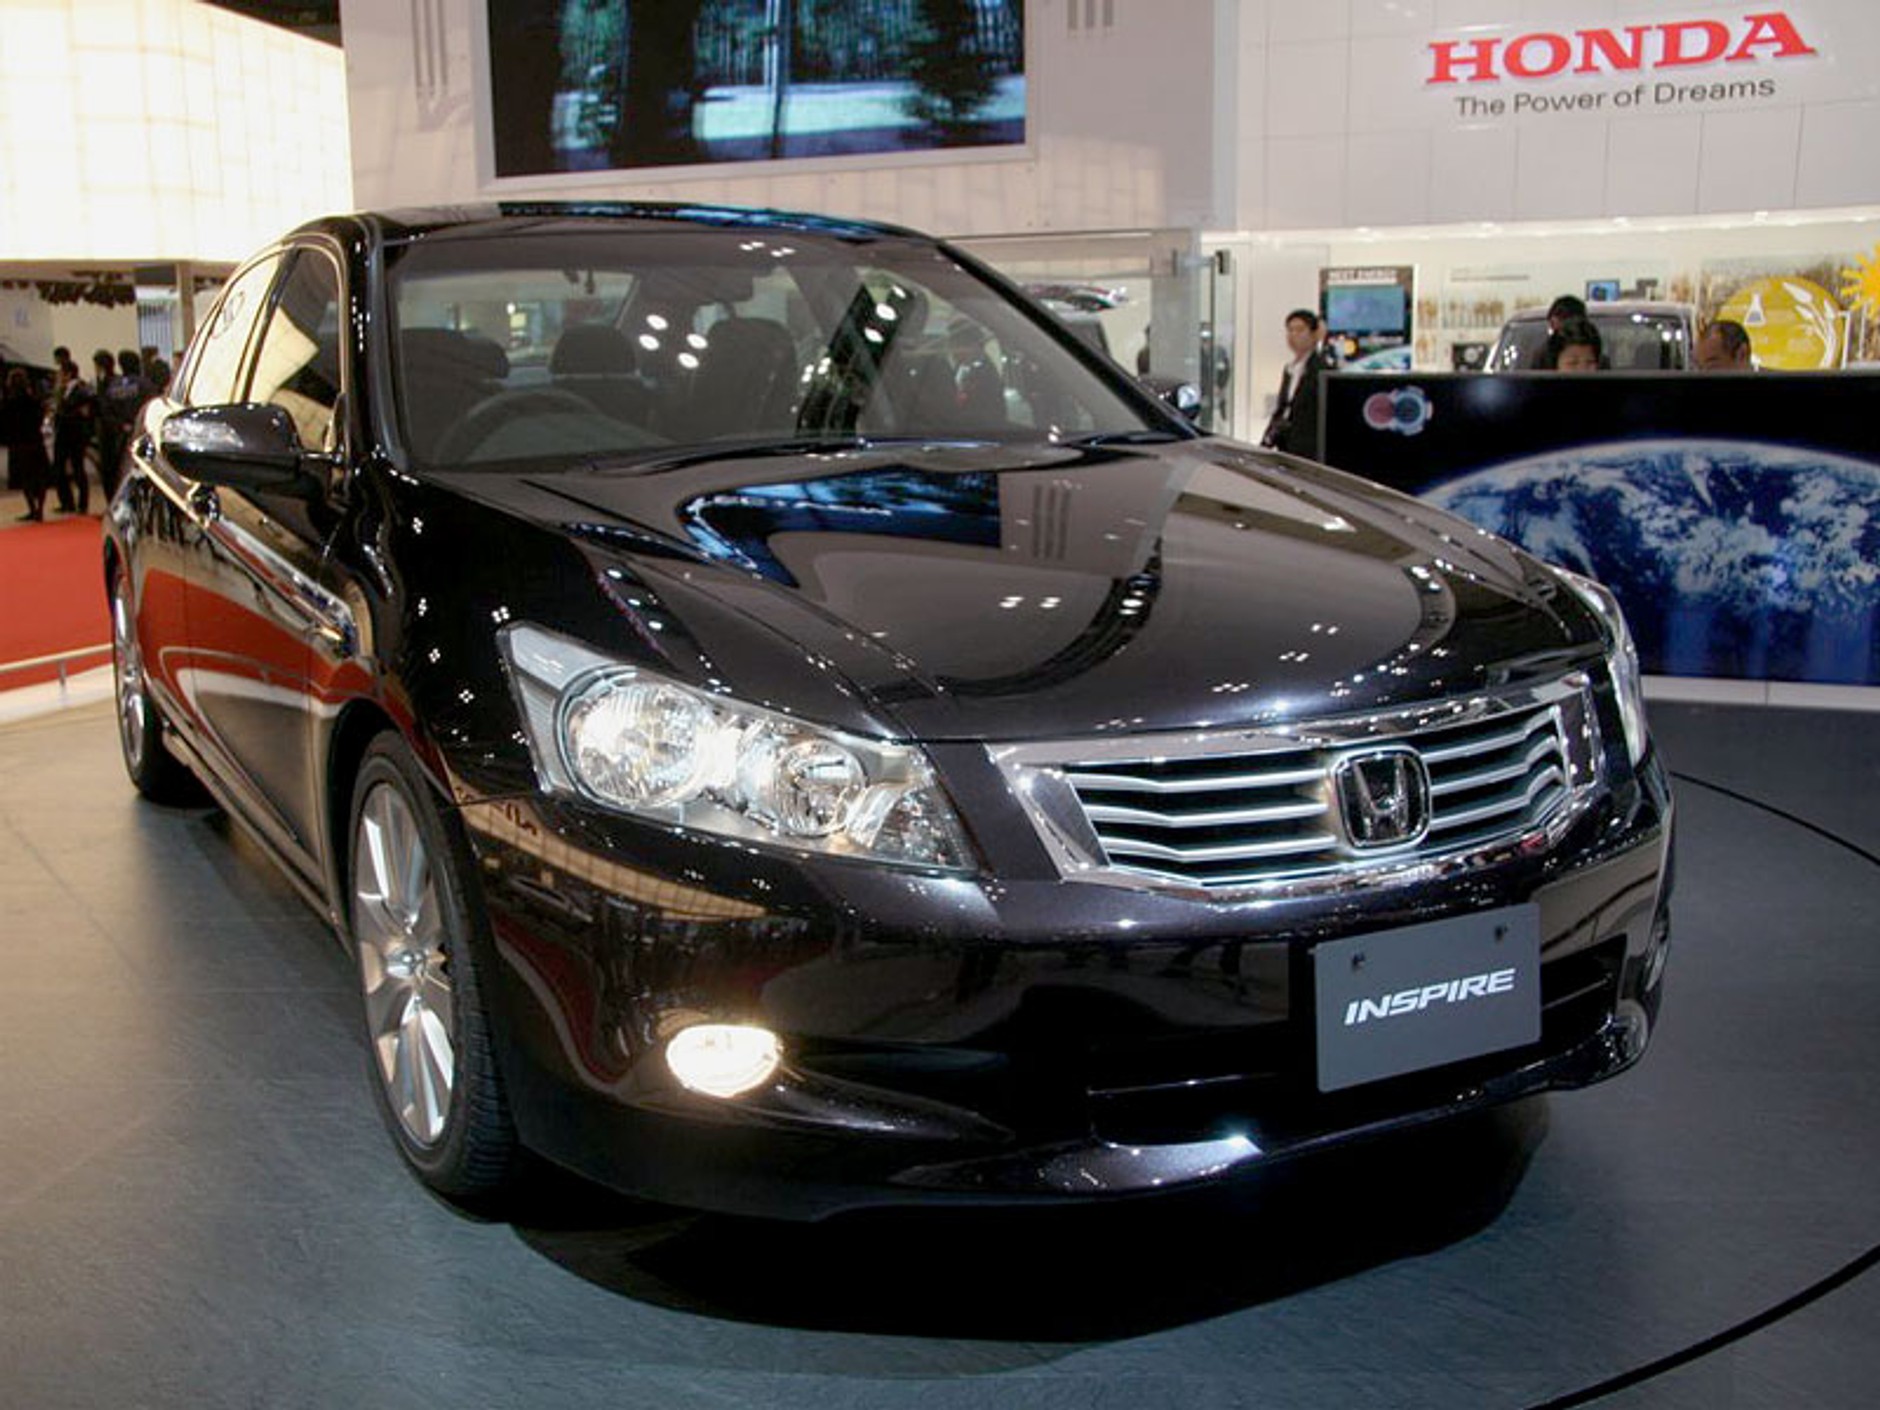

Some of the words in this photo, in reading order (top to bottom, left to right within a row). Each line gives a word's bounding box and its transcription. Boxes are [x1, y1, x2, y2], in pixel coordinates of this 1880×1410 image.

[1426, 12, 1817, 84] HONDA
[1455, 96, 1505, 116] The
[1513, 91, 1606, 113] Power
[1613, 84, 1646, 107] of
[1654, 79, 1776, 104] Dreams
[1344, 968, 1515, 1025] INSPIRE
